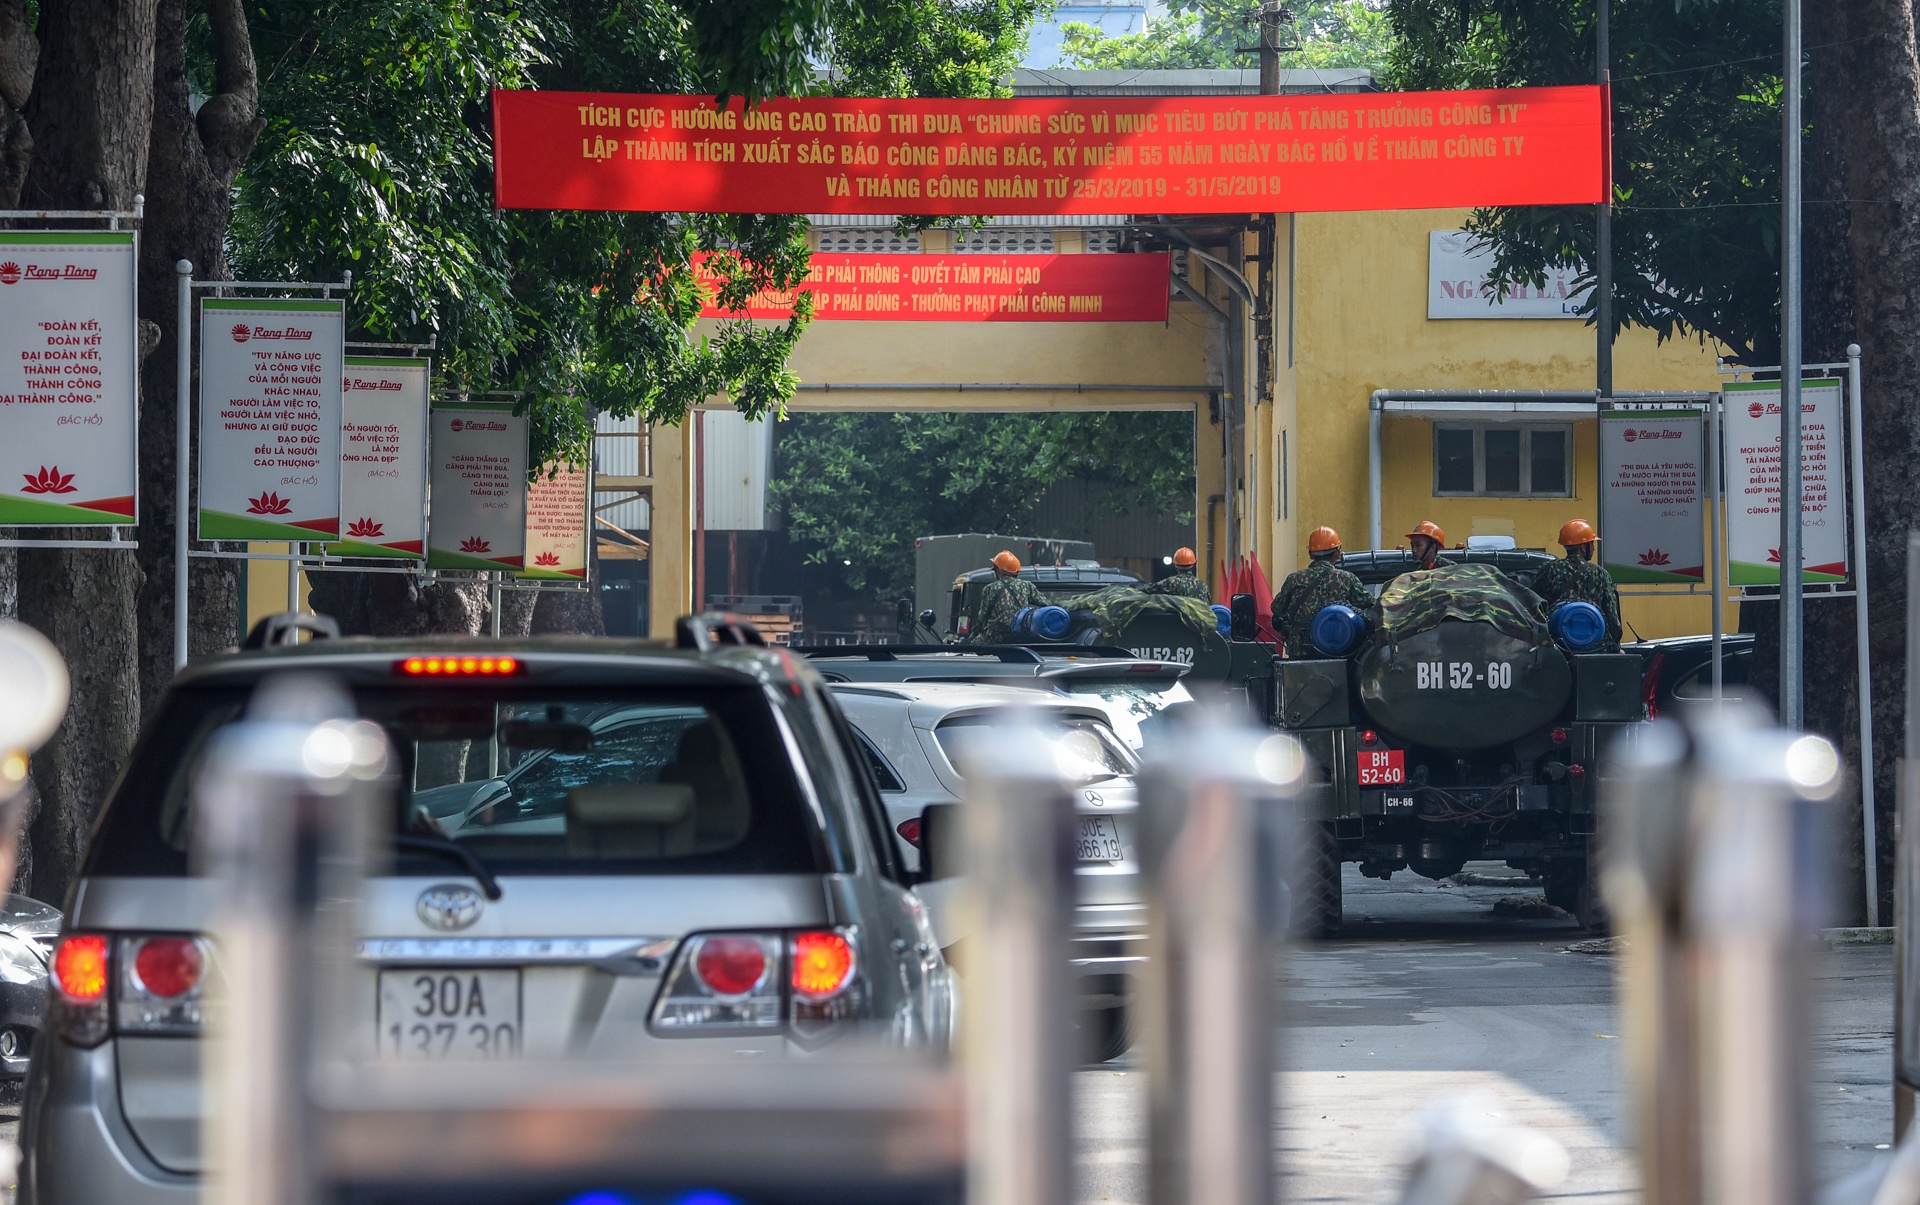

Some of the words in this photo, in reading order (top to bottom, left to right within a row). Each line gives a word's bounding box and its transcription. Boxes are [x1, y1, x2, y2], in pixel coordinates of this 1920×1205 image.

[579, 103, 621, 127] TÍCH
[627, 108, 664, 132] CỰC
[672, 102, 736, 130] HƯỞNG
[789, 112, 827, 132] CAO
[832, 111, 881, 133] TRÀO
[888, 114, 918, 134] THI
[924, 114, 963, 134] ĐUA
[1048, 110, 1086, 134] SỨC
[1092, 109, 1109, 133] VÌ
[1116, 114, 1158, 136] MỤC
[1164, 109, 1206, 132] TIÊU
[1213, 108, 1248, 131] BỨT
[1255, 108, 1293, 130] PHÁ
[1298, 107, 1349, 130] TĂNG
[1354, 100, 1433, 129] TRƯỞNG
[1439, 102, 1492, 126] CÔNG
[584, 135, 618, 162] LẬP
[624, 137, 687, 161] THÀNH
[694, 138, 735, 162] TÍCH
[744, 138, 790, 163] XUẤT
[798, 140, 835, 164] SẮC
[841, 141, 879, 165] BÁO
[888, 143, 939, 166] CÔNG
[946, 142, 997, 166] DÂNG
[1004, 144, 1047, 167] BÁC,
[1054, 140, 1077, 166] KỶ
[1084, 142, 1134, 169] NIỆM
[1140, 146, 1162, 165] 55
[1168, 142, 1213, 164] NĂM
[1220, 140, 1270, 163] NGÀY
[1278, 139, 1316, 163] BÁC
[1322, 136, 1347, 162] HỒ
[1353, 134, 1378, 161] VỀ
[1384, 136, 1438, 160] THĂM
[1444, 134, 1497, 158] CÔNG
[1502, 136, 1524, 156] TY
[826, 174, 850, 196] VÀ
[856, 175, 920, 198] THÁNG
[927, 175, 978, 198] CÔNG
[985, 175, 1038, 198] NHÂN
[1045, 174, 1069, 198] TỪ
[1074, 178, 1167, 198] 25/3/2019
[1186, 176, 1280, 197] 31/5/2019
[826, 260, 855, 282] PHẢI
[860, 263, 900, 284] THÔNG
[912, 260, 950, 285] QUYẾT
[954, 264, 980, 284] TÂM
[984, 260, 1012, 284] PHẢI
[1016, 266, 1040, 284] CAO
[1440, 274, 1529, 299] NGÀH
[833, 287, 862, 311] PHẢI
[866, 290, 900, 311] ĐÚNG
[912, 288, 961, 312] THƯỞNG
[964, 294, 996, 315] PHẠT
[1000, 288, 1028, 312] PHẢI
[1032, 292, 1066, 312] CÔNG
[1070, 296, 1102, 312] MINH
[81, 319, 101, 332] KẾT,
[47, 334, 80, 345] ĐOÀN
[84, 333, 102, 345] KẾT
[22, 351, 41, 362] ĐẠI
[44, 349, 77, 360] ĐOÀN
[81, 348, 101, 361] KẾT,
[275, 350, 302, 360] NĂNG
[305, 353, 321, 362] LỰC
[23, 363, 61, 374] THÀNH
[64, 363, 102, 375] CÔNG,
[255, 362, 267, 371] VÀ
[270, 362, 298, 372] CÔNG
[301, 362, 321, 374] VIỆC
[27, 378, 64, 389] THÀNH
[67, 378, 102, 389] CÔNG
[248, 373, 268, 383] CỦA
[271, 373, 289, 383] MỖI
[292, 374, 321, 383] NGƯỜI
[265, 386, 290, 395] KHÁC
[293, 388, 321, 396] NHAU,
[18, 392, 55, 403] THÀNH
[230, 397, 260, 406] NGƯỜI
[262, 397, 281, 407] LÀM
[283, 398, 304, 409] VIỆC
[306, 400, 321, 408] TO,
[57, 414, 82, 426] (BÁC
[84, 413, 103, 426] HỒ)
[221, 409, 251, 418] NGƯỜI
[254, 409, 272, 419] LÀM
[275, 410, 295, 421] VIỆC
[298, 410, 320, 420] NHỎ,
[260, 423, 269, 431] AI
[272, 421, 289, 431] GIỮ
[291, 424, 318, 433] ĐƯỢC
[278, 436, 298, 445] ĐẠO
[301, 434, 320, 443] ĐỨC
[350, 432, 365, 442] MỖI
[367, 433, 384, 444] VIỆC
[386, 433, 399, 442] TỐT
[255, 444, 272, 455] ĐỀU
[275, 445, 285, 455] LÀ
[288, 446, 317, 455] NGƯỜI
[372, 443, 381, 452] LÀ
[383, 443, 399, 454] MỘT
[340, 453, 360, 461] ÔNG
[1130, 648, 1150, 660] BH
[1153, 646, 1194, 666] 52-62
[1417, 662, 1443, 689] BH
[1372, 752, 1388, 766] BH
[1362, 768, 1400, 783] 52-60
[1387, 798, 1414, 806] CH-66
[1080, 818, 1106, 836] 30E
[414, 976, 486, 1017] 30A
